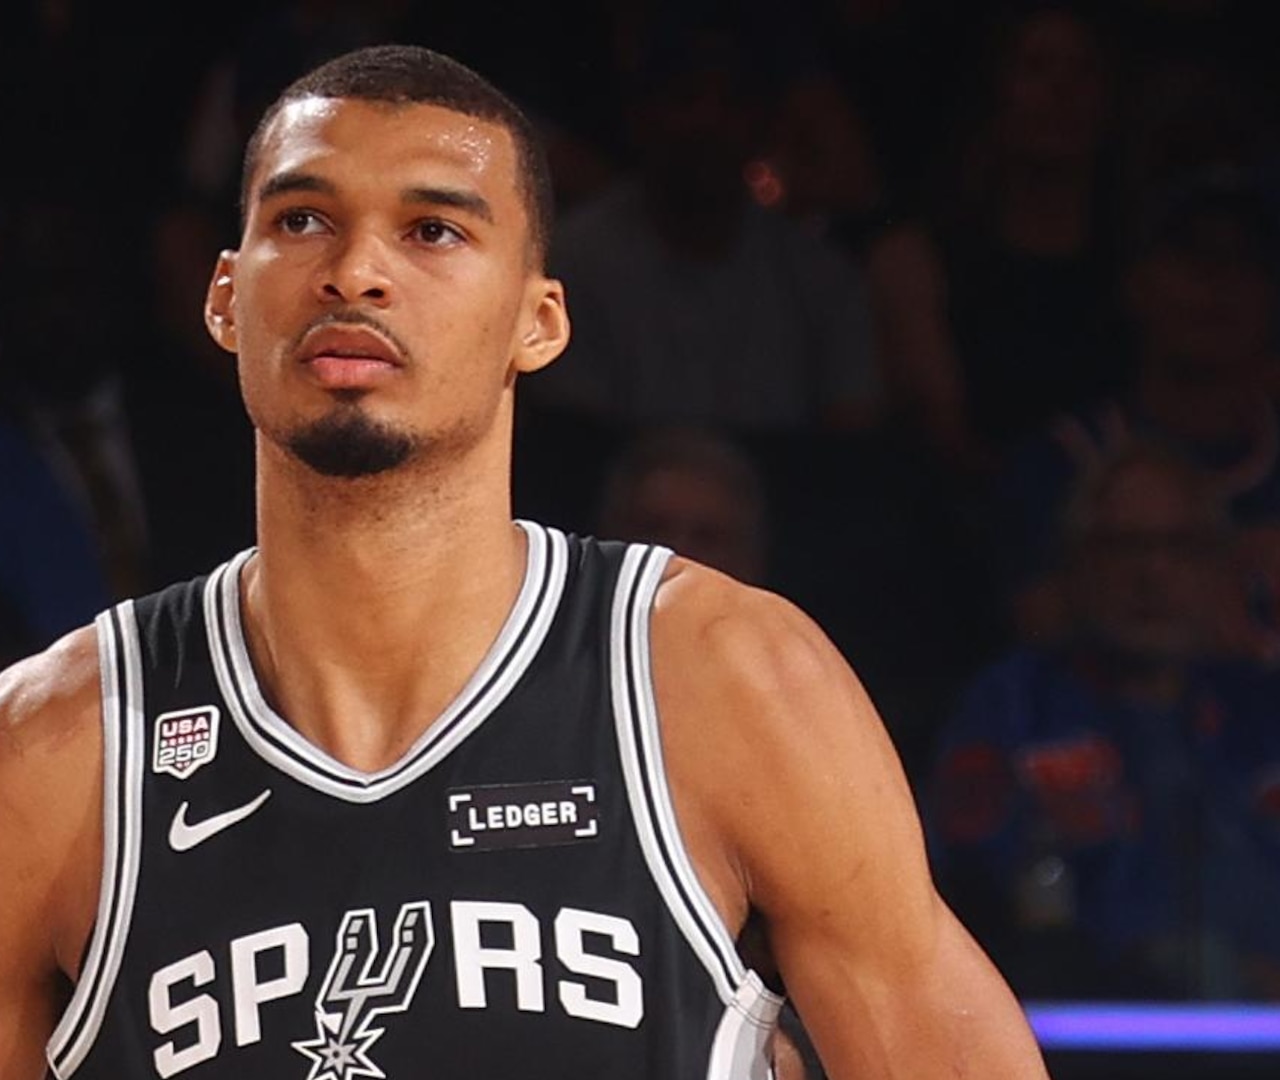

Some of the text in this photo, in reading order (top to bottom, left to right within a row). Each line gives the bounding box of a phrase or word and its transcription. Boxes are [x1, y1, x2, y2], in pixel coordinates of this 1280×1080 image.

[162, 716, 209, 738] USA
[159, 741, 209, 765] 250
[469, 800, 578, 830] LEDGER
